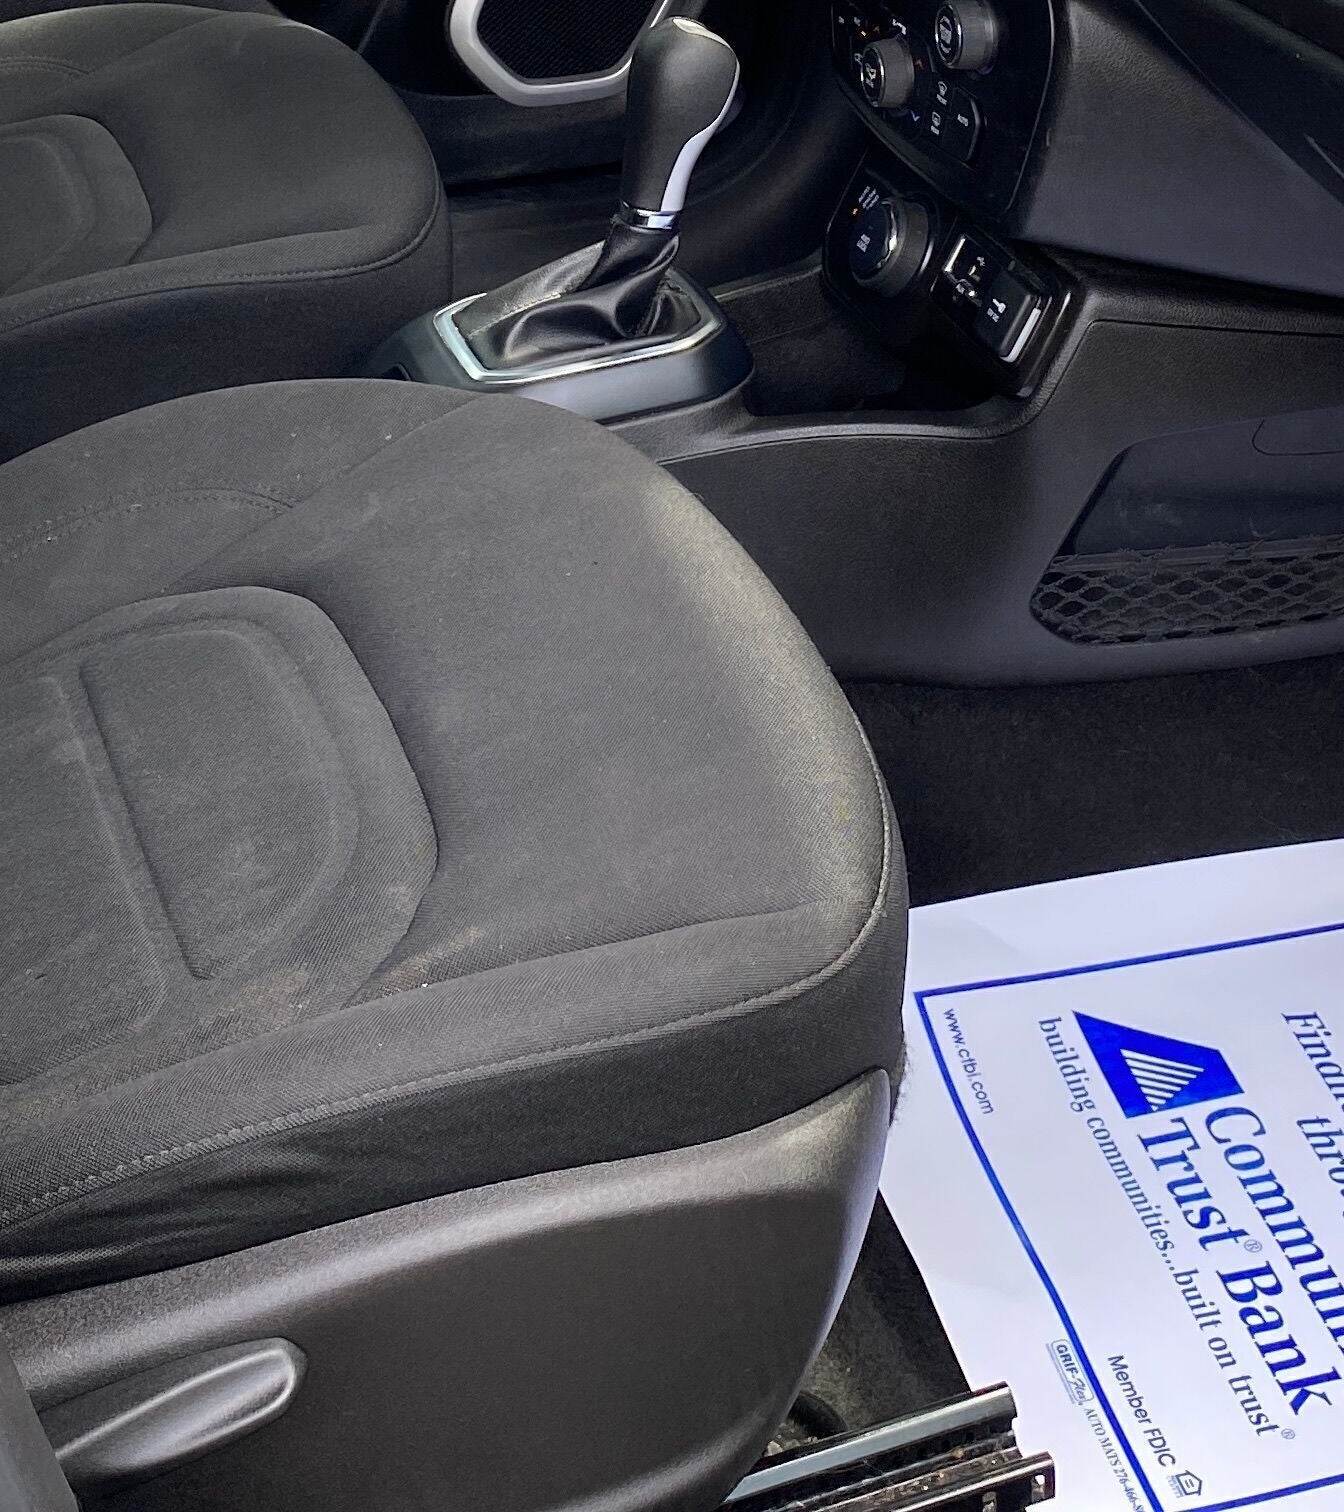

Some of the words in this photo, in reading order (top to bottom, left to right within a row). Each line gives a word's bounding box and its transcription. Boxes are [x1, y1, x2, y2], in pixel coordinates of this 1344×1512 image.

[1038, 1016, 1096, 1113] building
[1208, 1336, 1238, 1370] on
[1108, 1354, 1152, 1424] Member
[1143, 1428, 1176, 1467] FDIC
[1215, 1260, 1343, 1416] Bank
